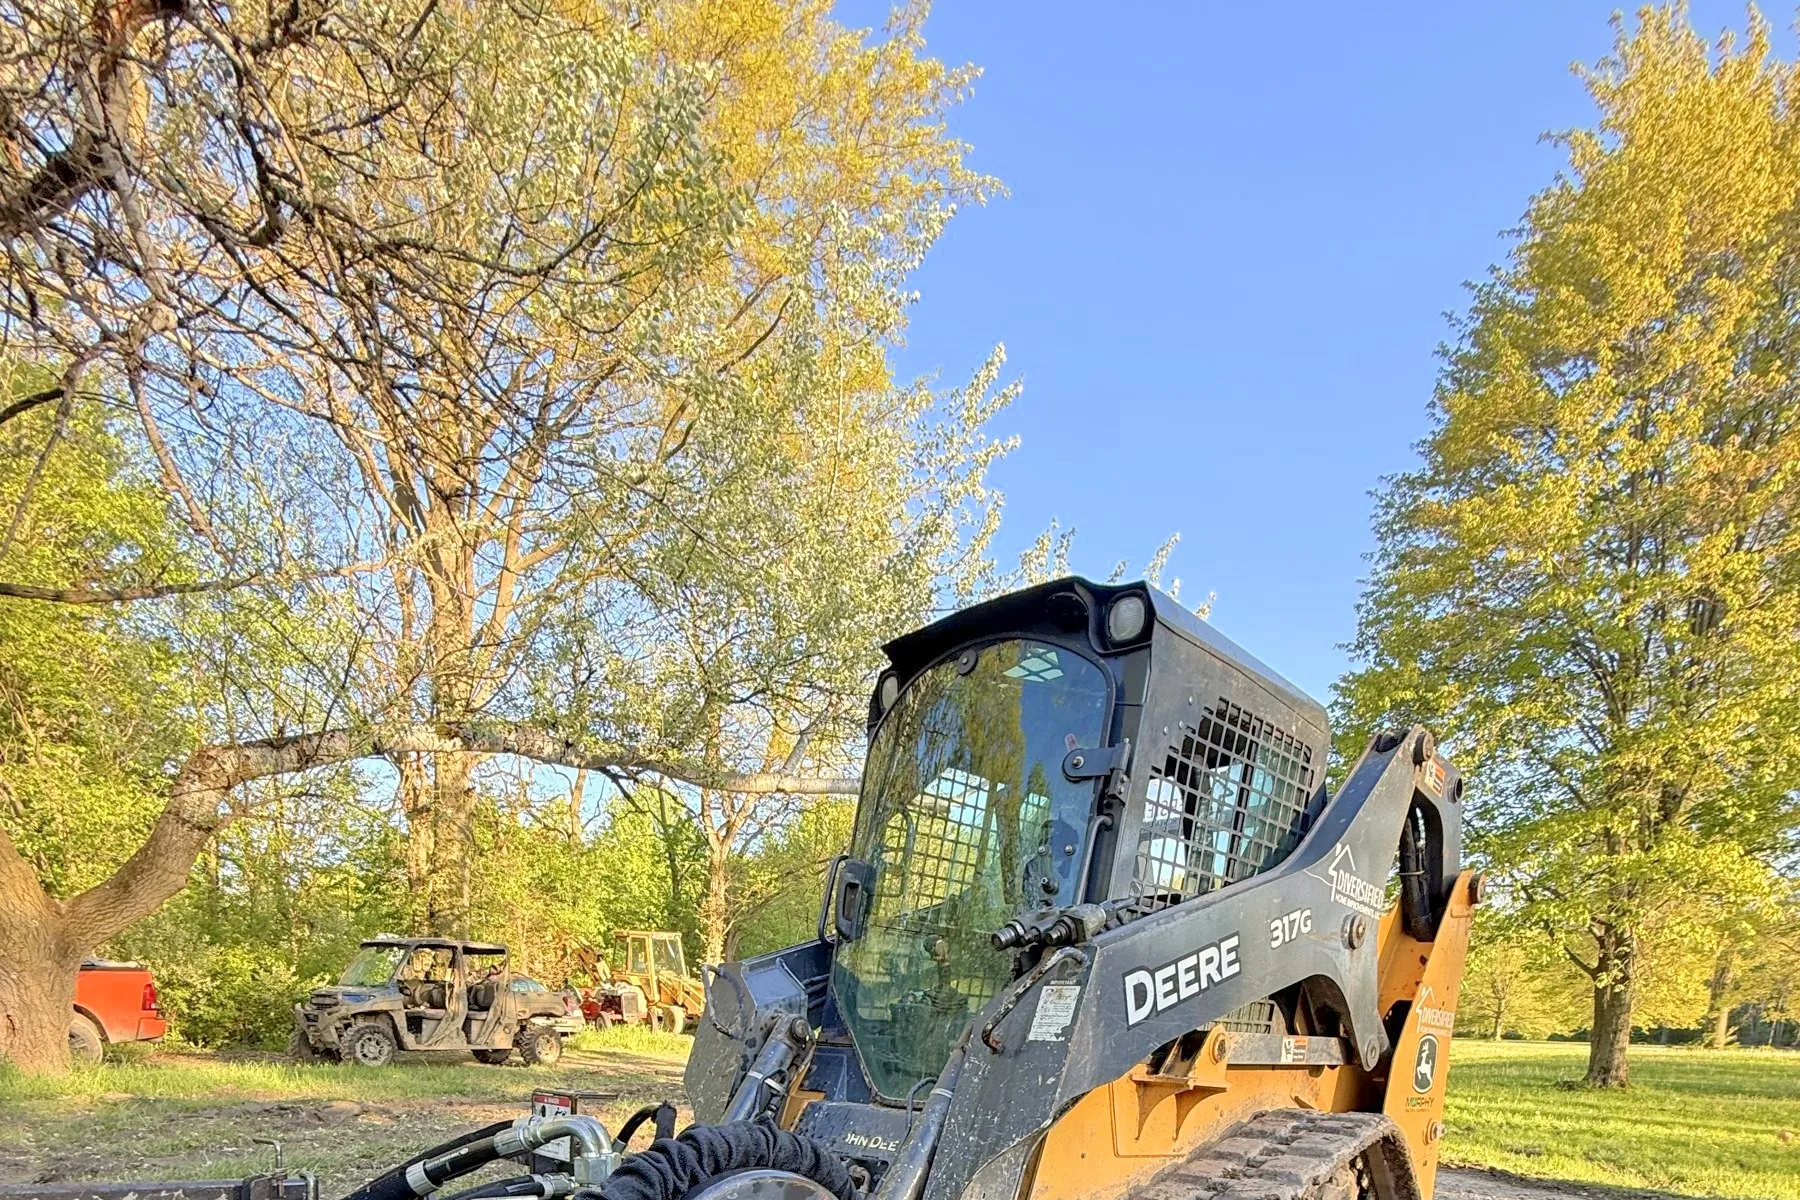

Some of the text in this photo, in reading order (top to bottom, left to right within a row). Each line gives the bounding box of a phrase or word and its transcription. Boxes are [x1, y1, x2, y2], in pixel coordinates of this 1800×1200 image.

[1337, 869, 1384, 909] DIVERSIFIED
[1270, 909, 1312, 949] 317G
[1124, 935, 1240, 1026] DEERE
